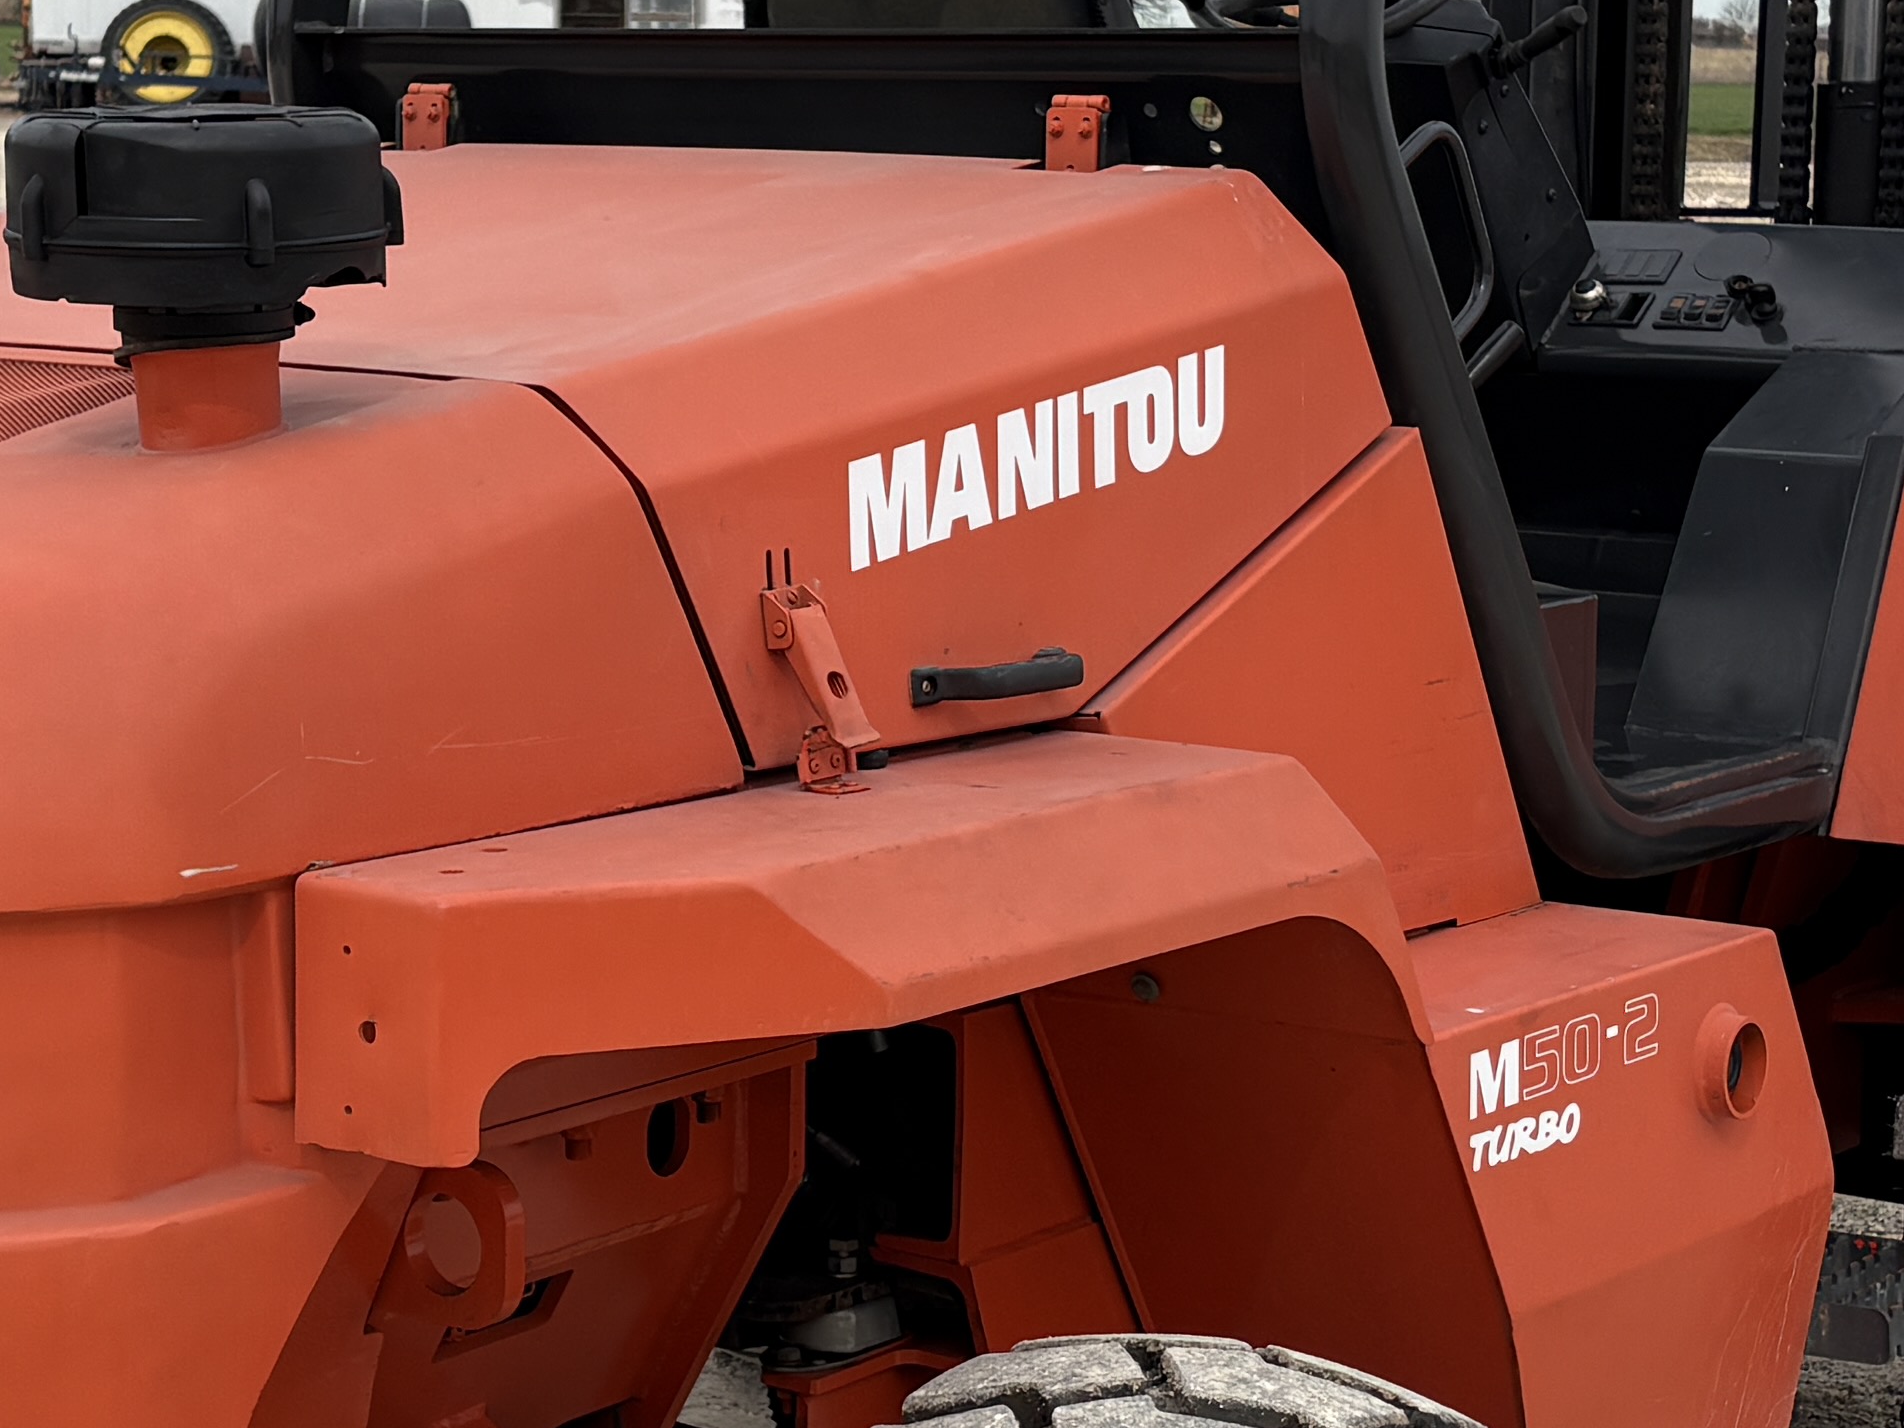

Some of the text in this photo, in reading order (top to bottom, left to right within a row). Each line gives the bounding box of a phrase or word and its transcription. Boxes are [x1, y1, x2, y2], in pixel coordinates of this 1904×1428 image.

[846, 344, 1227, 573] MANITOU
[1467, 992, 1661, 1122] M50-2
[1467, 1101, 1582, 1174] TURBO
